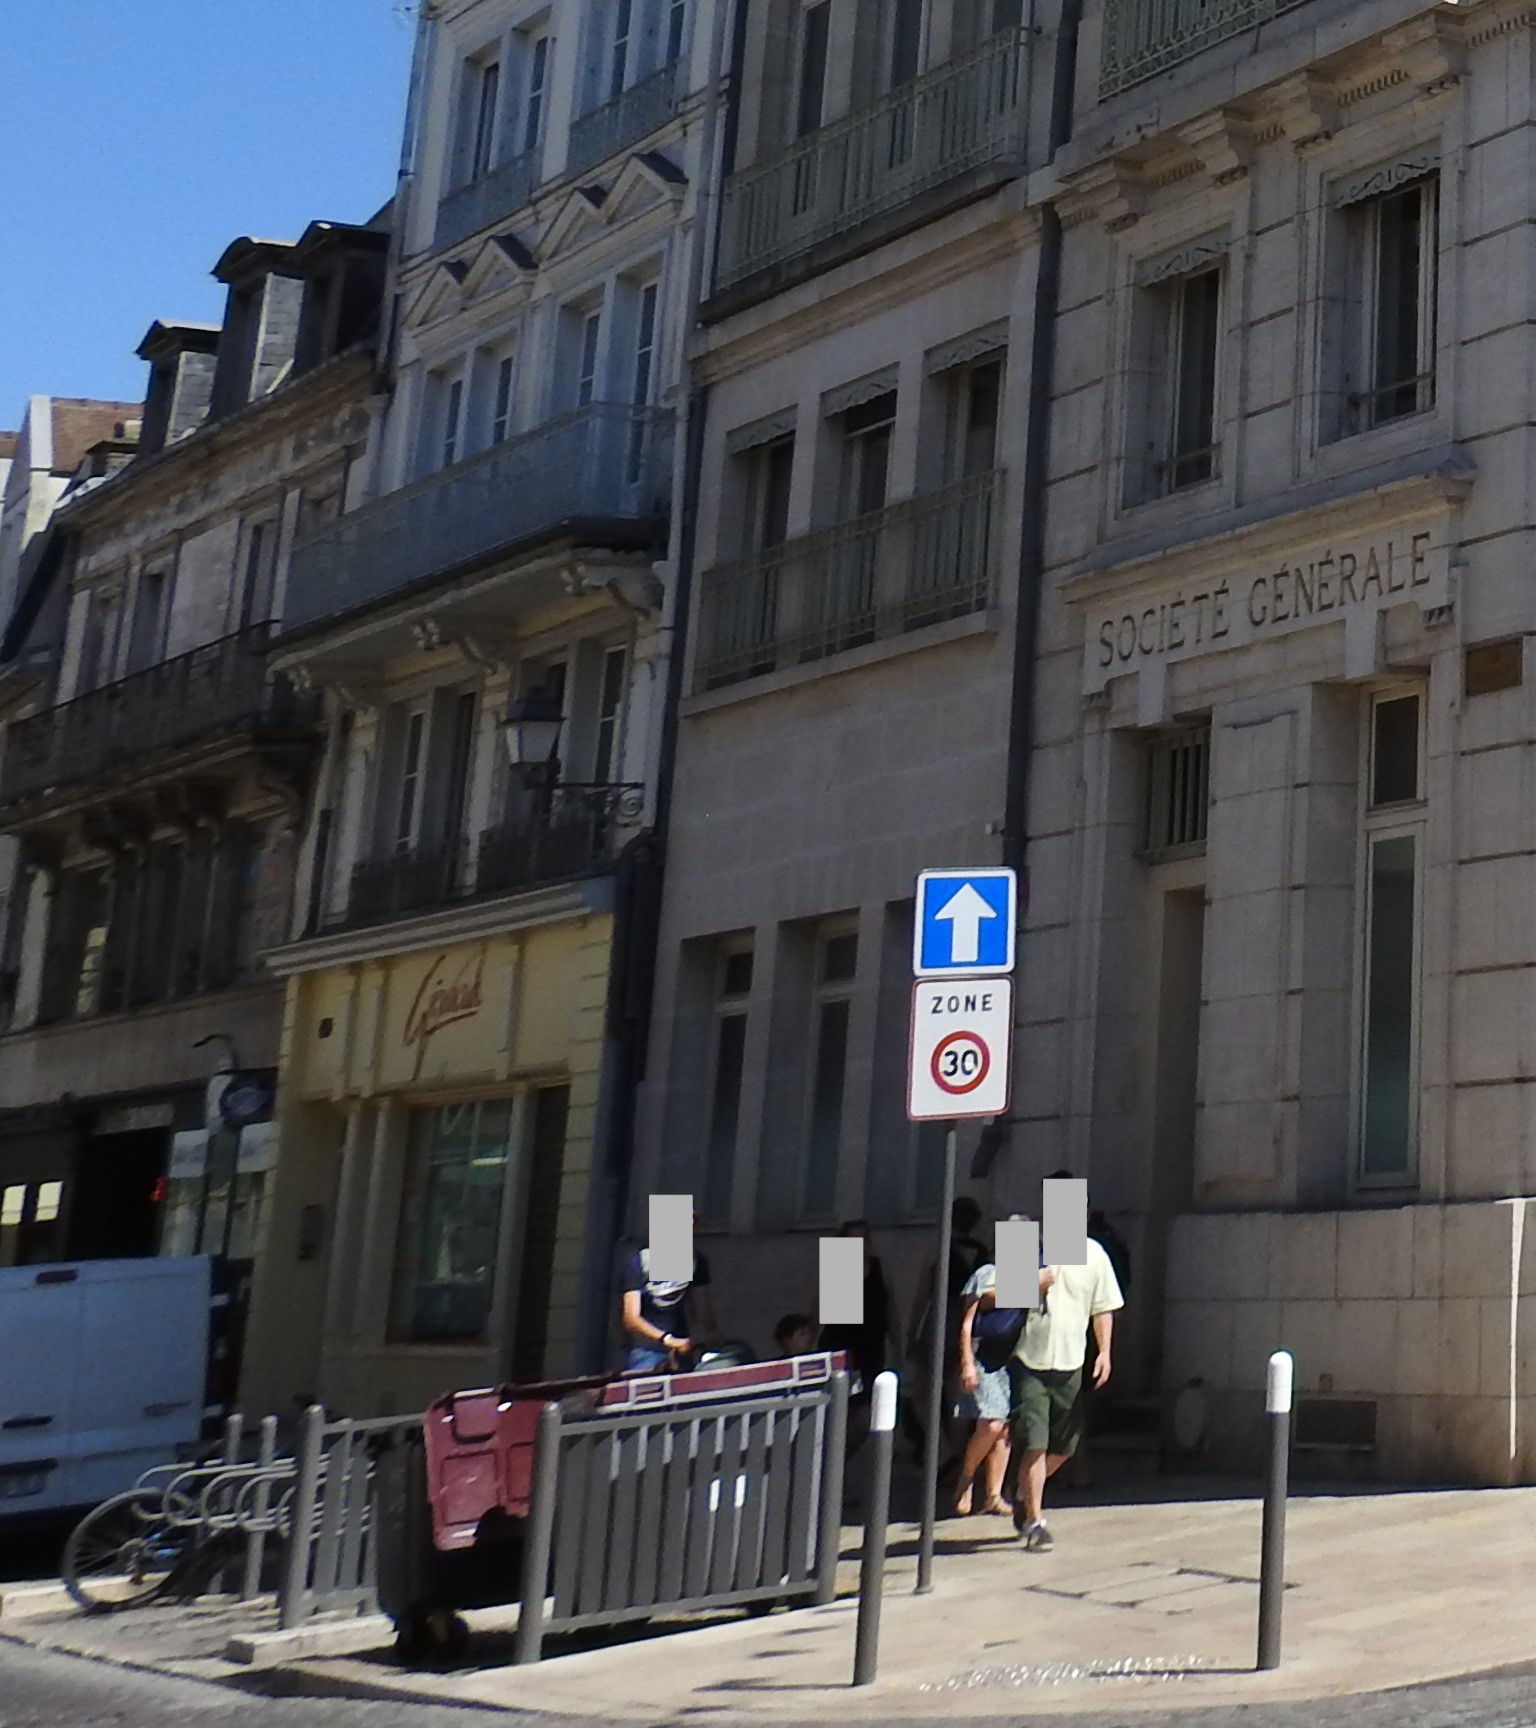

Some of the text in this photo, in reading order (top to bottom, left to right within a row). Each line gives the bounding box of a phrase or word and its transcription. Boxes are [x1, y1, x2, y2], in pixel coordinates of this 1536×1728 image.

[1099, 530, 1431, 668] SOCIÉTÉ GÉNÉRALE
[931, 992, 994, 1014] ZONE
[942, 1049, 979, 1077] 30
